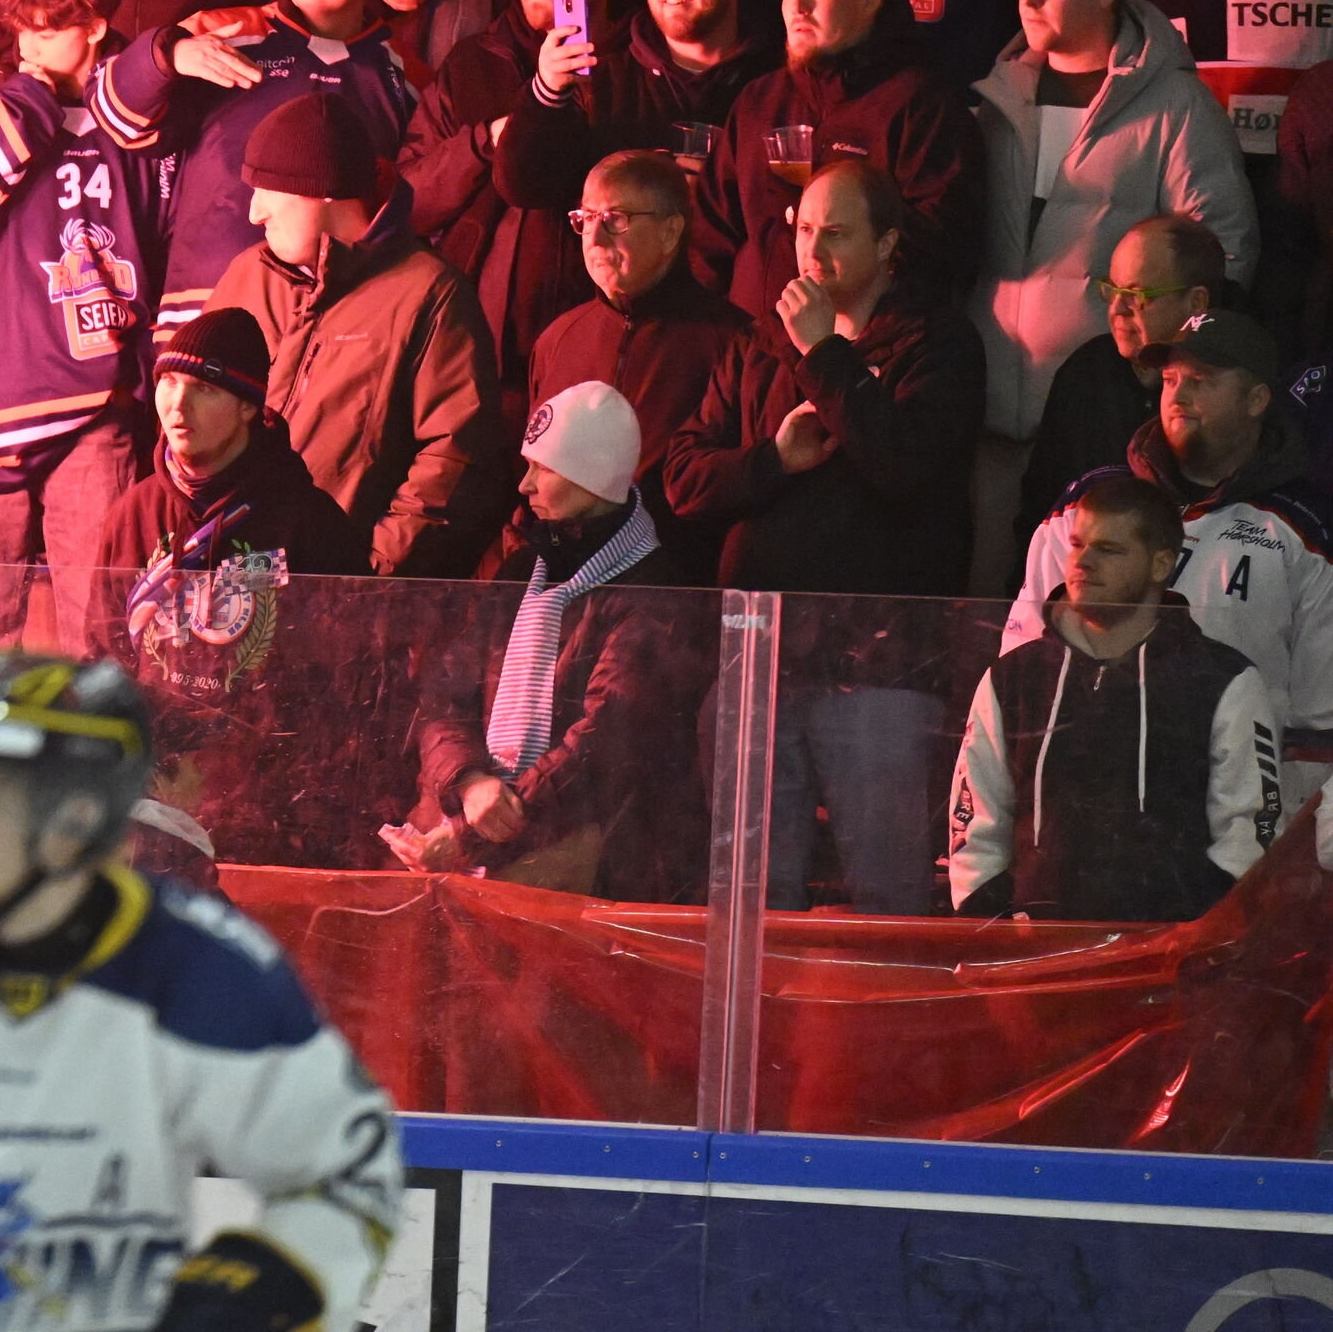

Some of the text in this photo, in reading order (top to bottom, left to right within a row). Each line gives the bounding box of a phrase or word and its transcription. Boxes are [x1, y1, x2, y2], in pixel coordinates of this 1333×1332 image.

[56, 162, 112, 210] 34
[1233, 518, 1268, 537] TEAM
[1224, 553, 1252, 603] A
